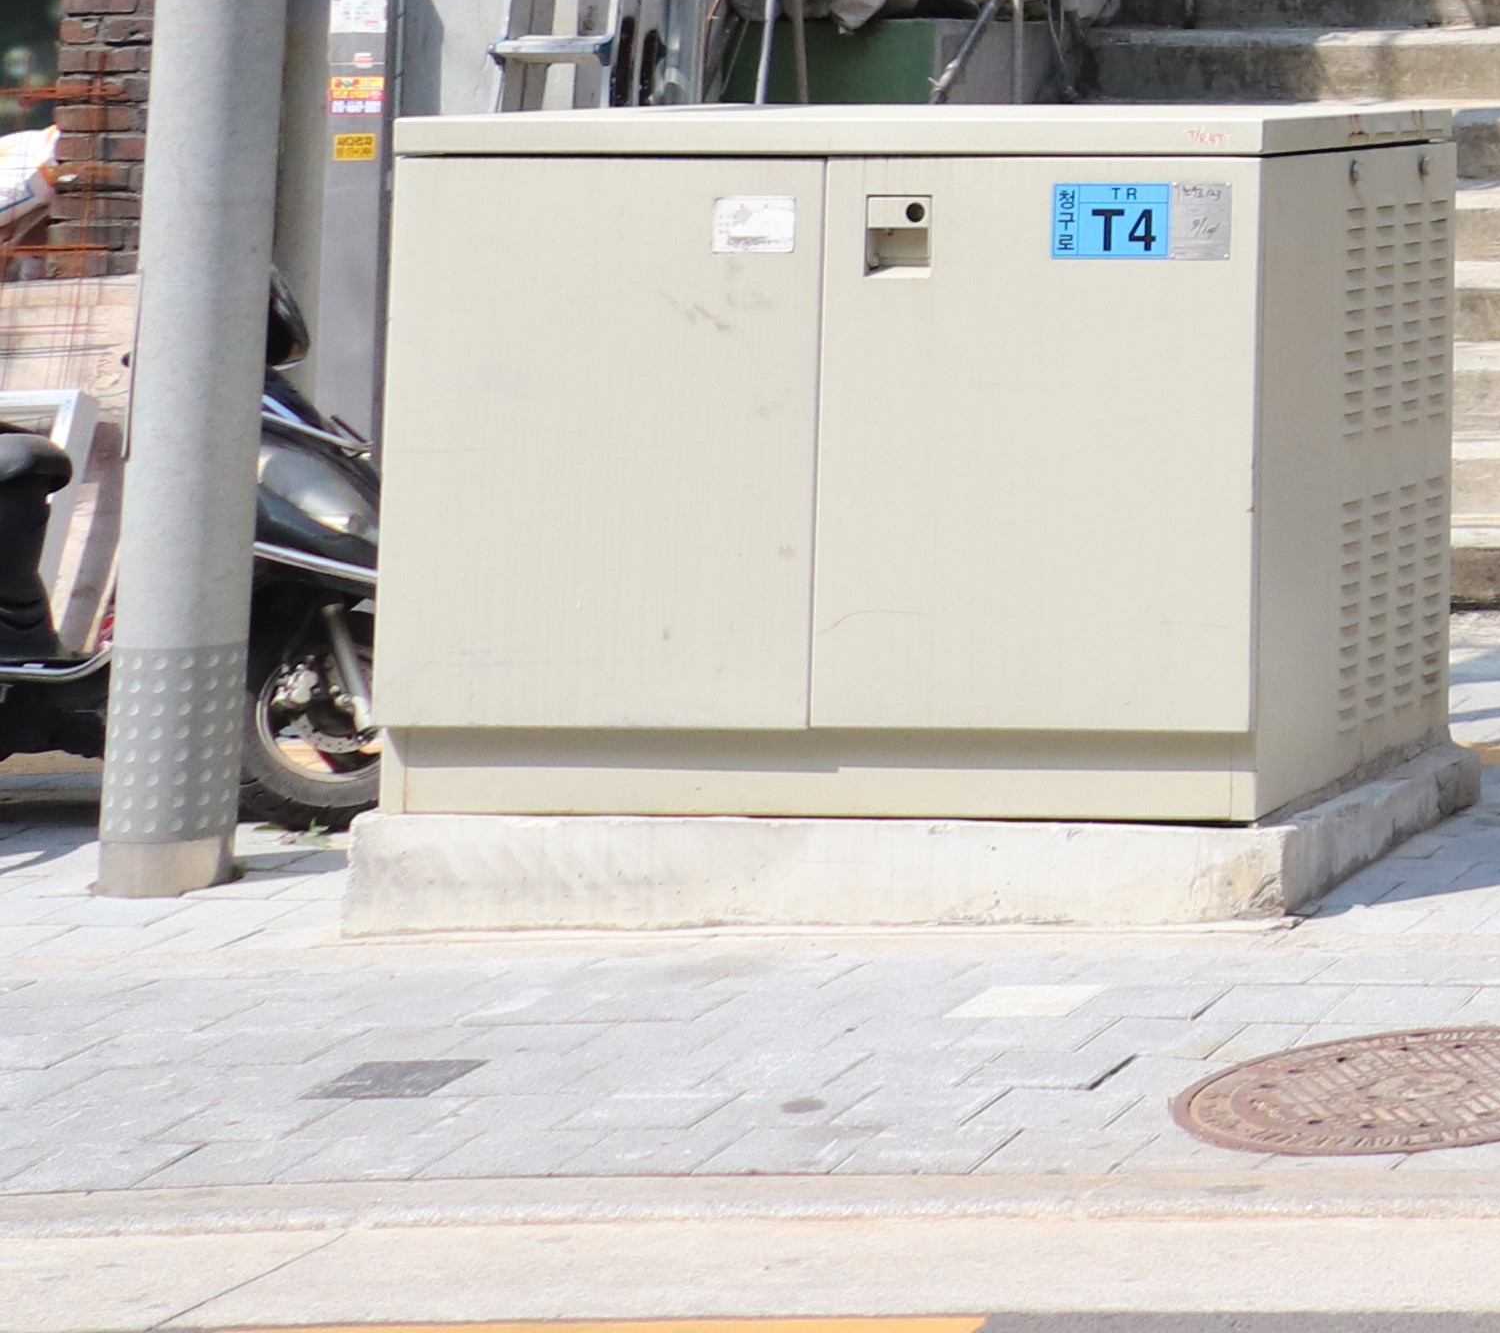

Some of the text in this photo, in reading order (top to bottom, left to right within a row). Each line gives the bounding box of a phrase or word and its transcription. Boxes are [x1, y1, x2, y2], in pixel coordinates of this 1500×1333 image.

[1111, 187, 1138, 200] TR
[1057, 190, 1076, 251] 청구로
[1091, 208, 1157, 252] T4
